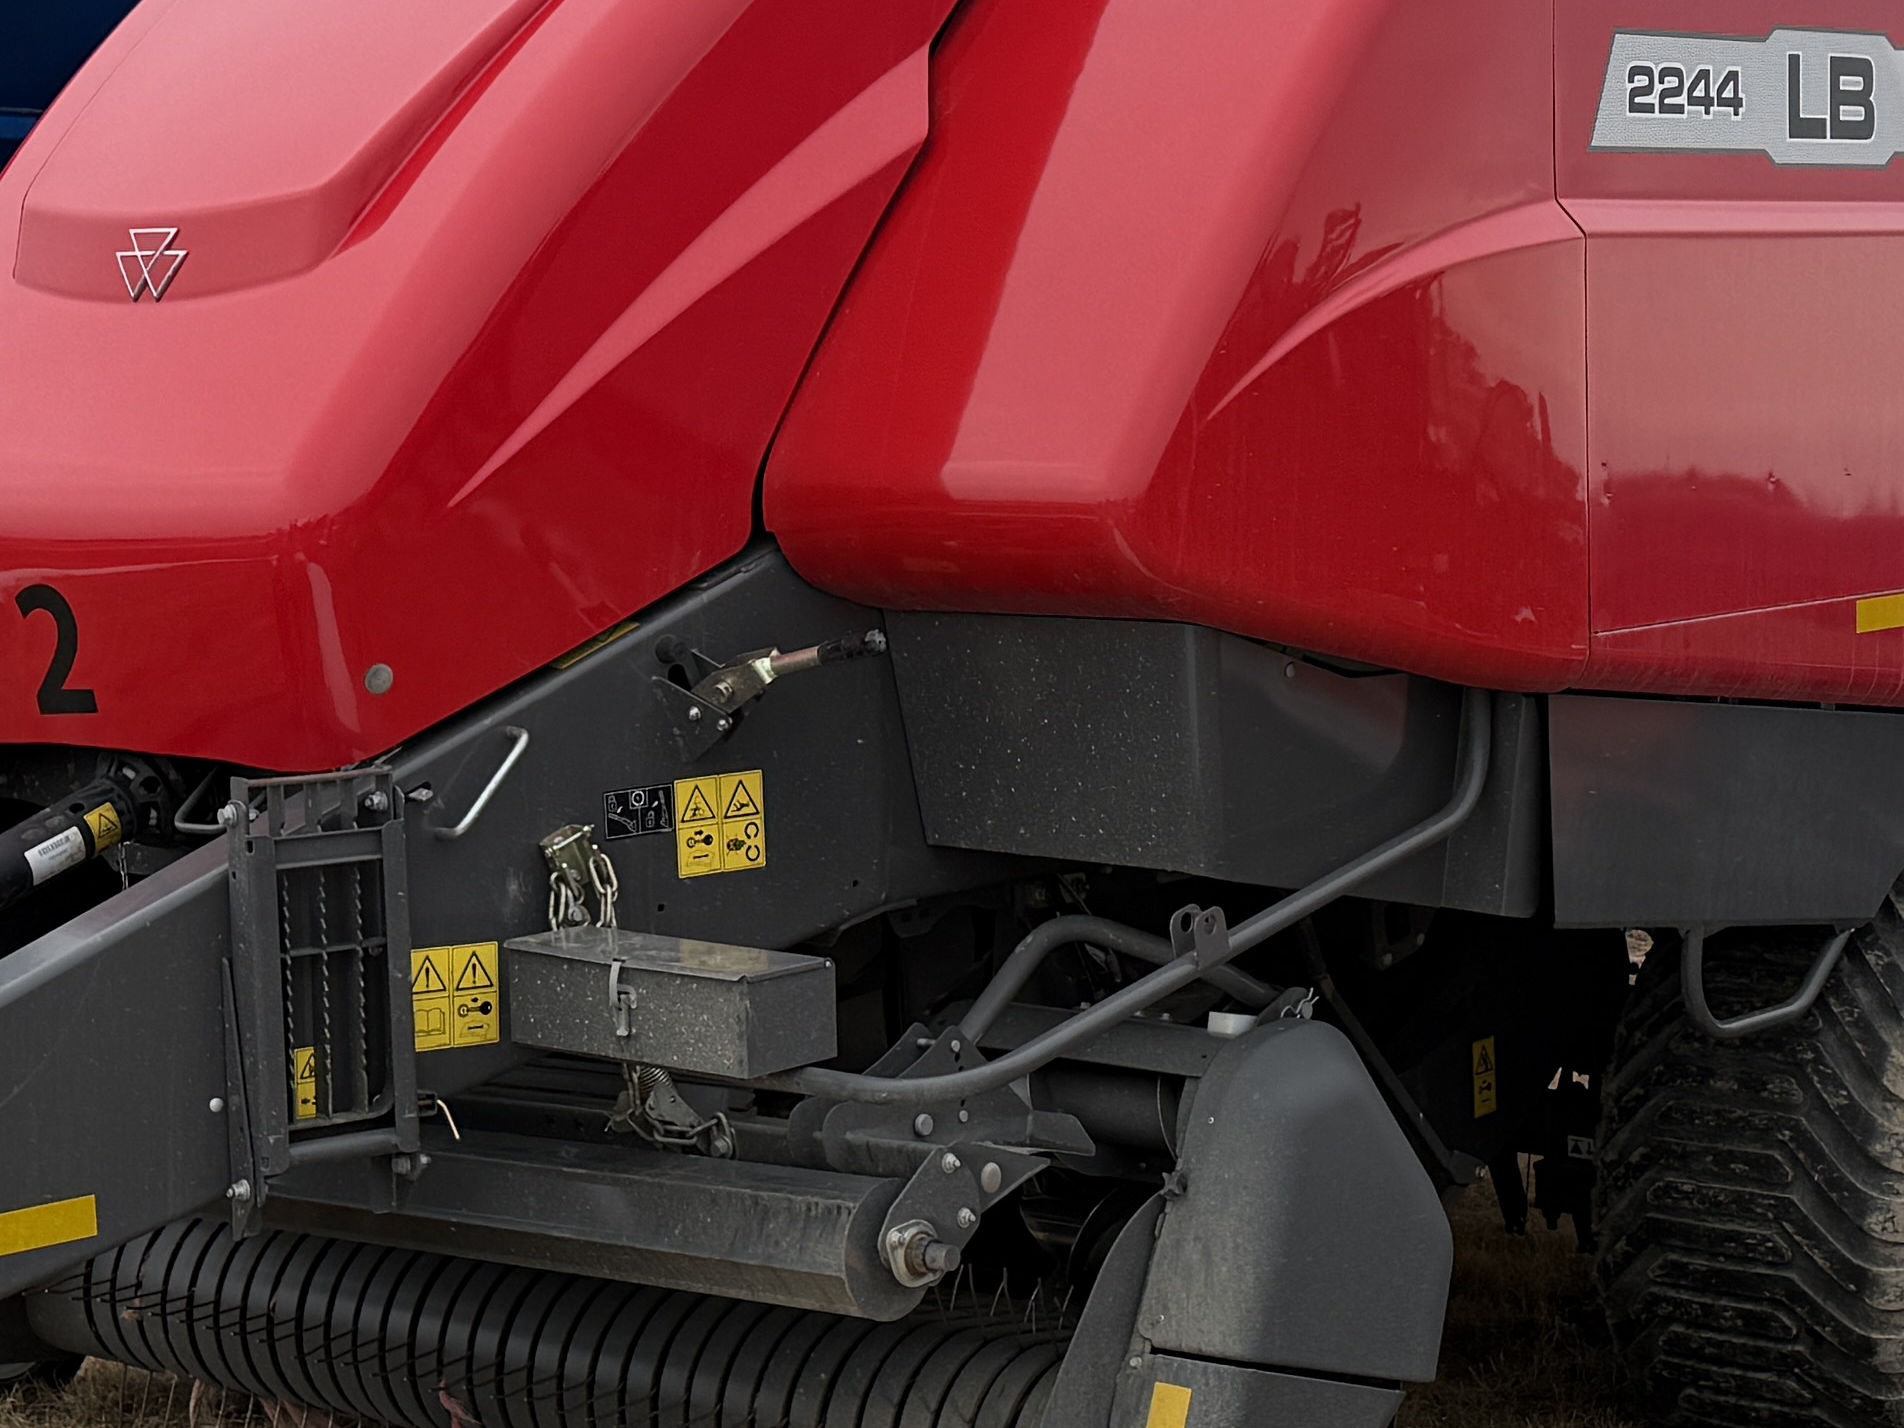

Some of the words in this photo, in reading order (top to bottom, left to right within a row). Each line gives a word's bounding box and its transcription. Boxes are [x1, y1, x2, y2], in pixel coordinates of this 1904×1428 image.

[1626, 62, 1745, 119] 2244
[1787, 51, 1876, 142] LB
[14, 583, 100, 716] 2
